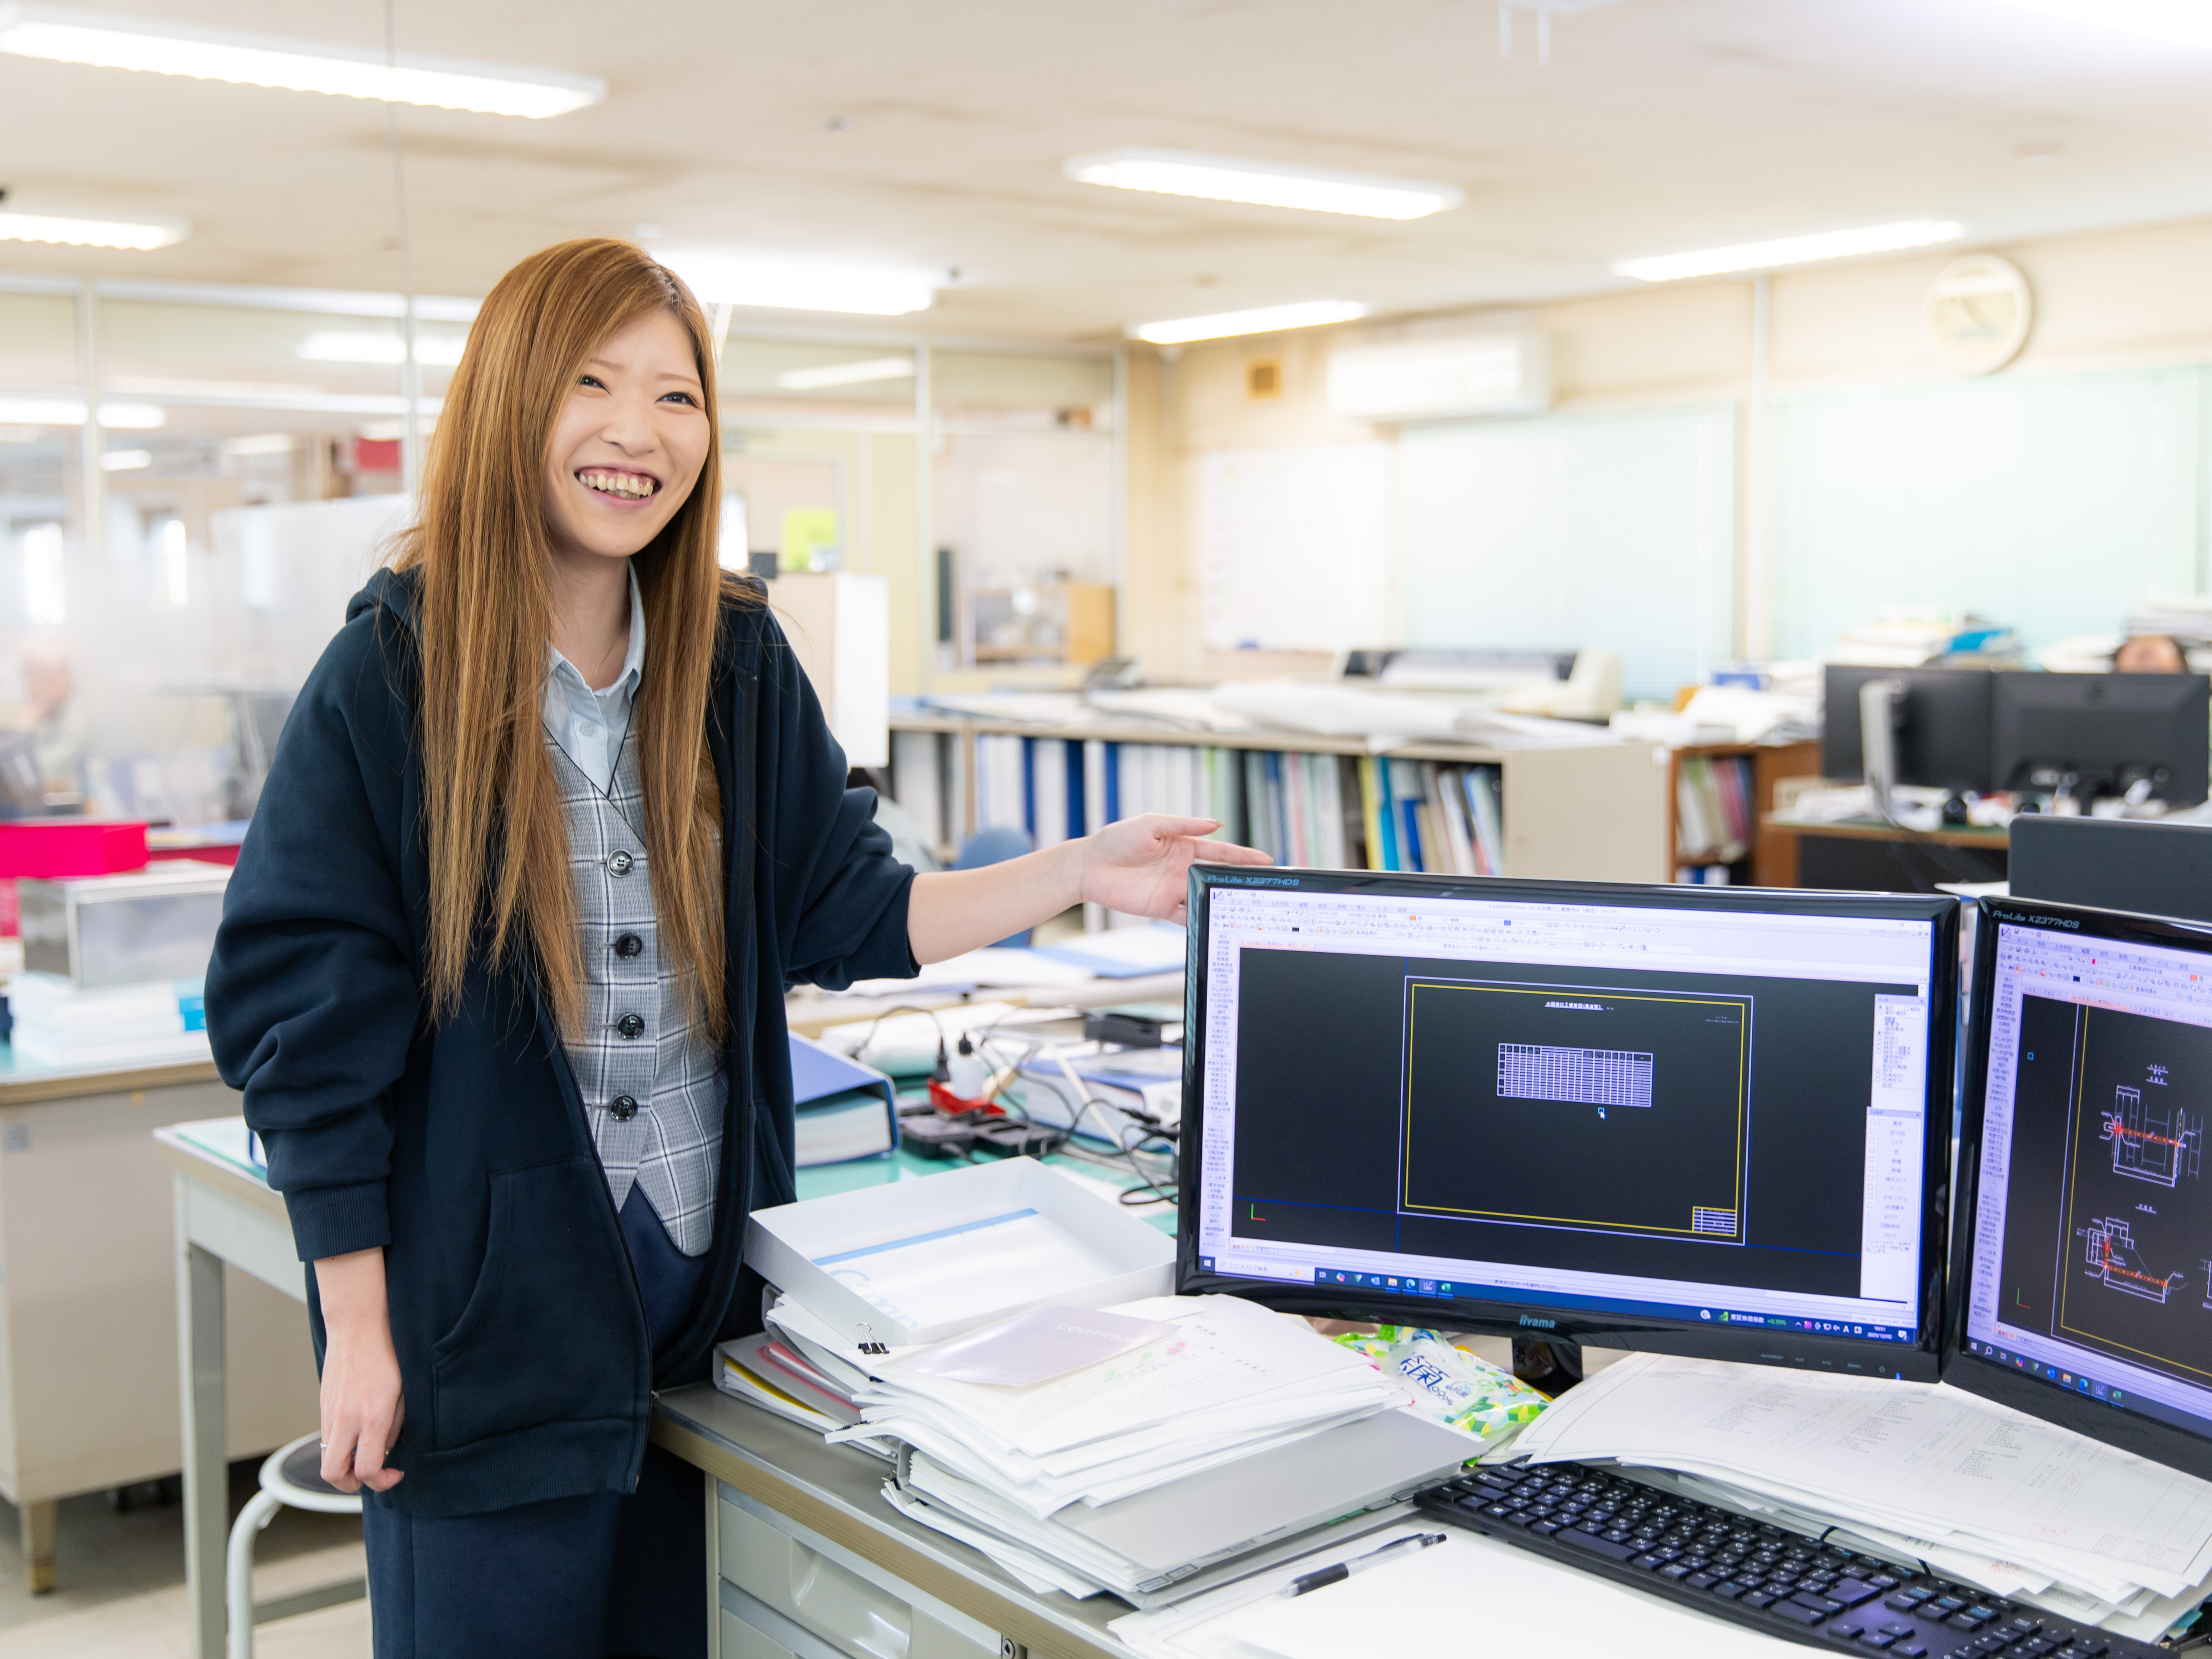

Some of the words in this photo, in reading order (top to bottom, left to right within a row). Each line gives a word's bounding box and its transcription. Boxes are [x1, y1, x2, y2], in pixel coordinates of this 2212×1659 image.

[1207, 875, 1243, 884] ProLite
[1245, 877, 1300, 886] X2377HDS
[1993, 910, 2026, 922] ProLite
[2028, 915, 2080, 929] X2377HDS
[1519, 1314, 1556, 1329] iiyama
